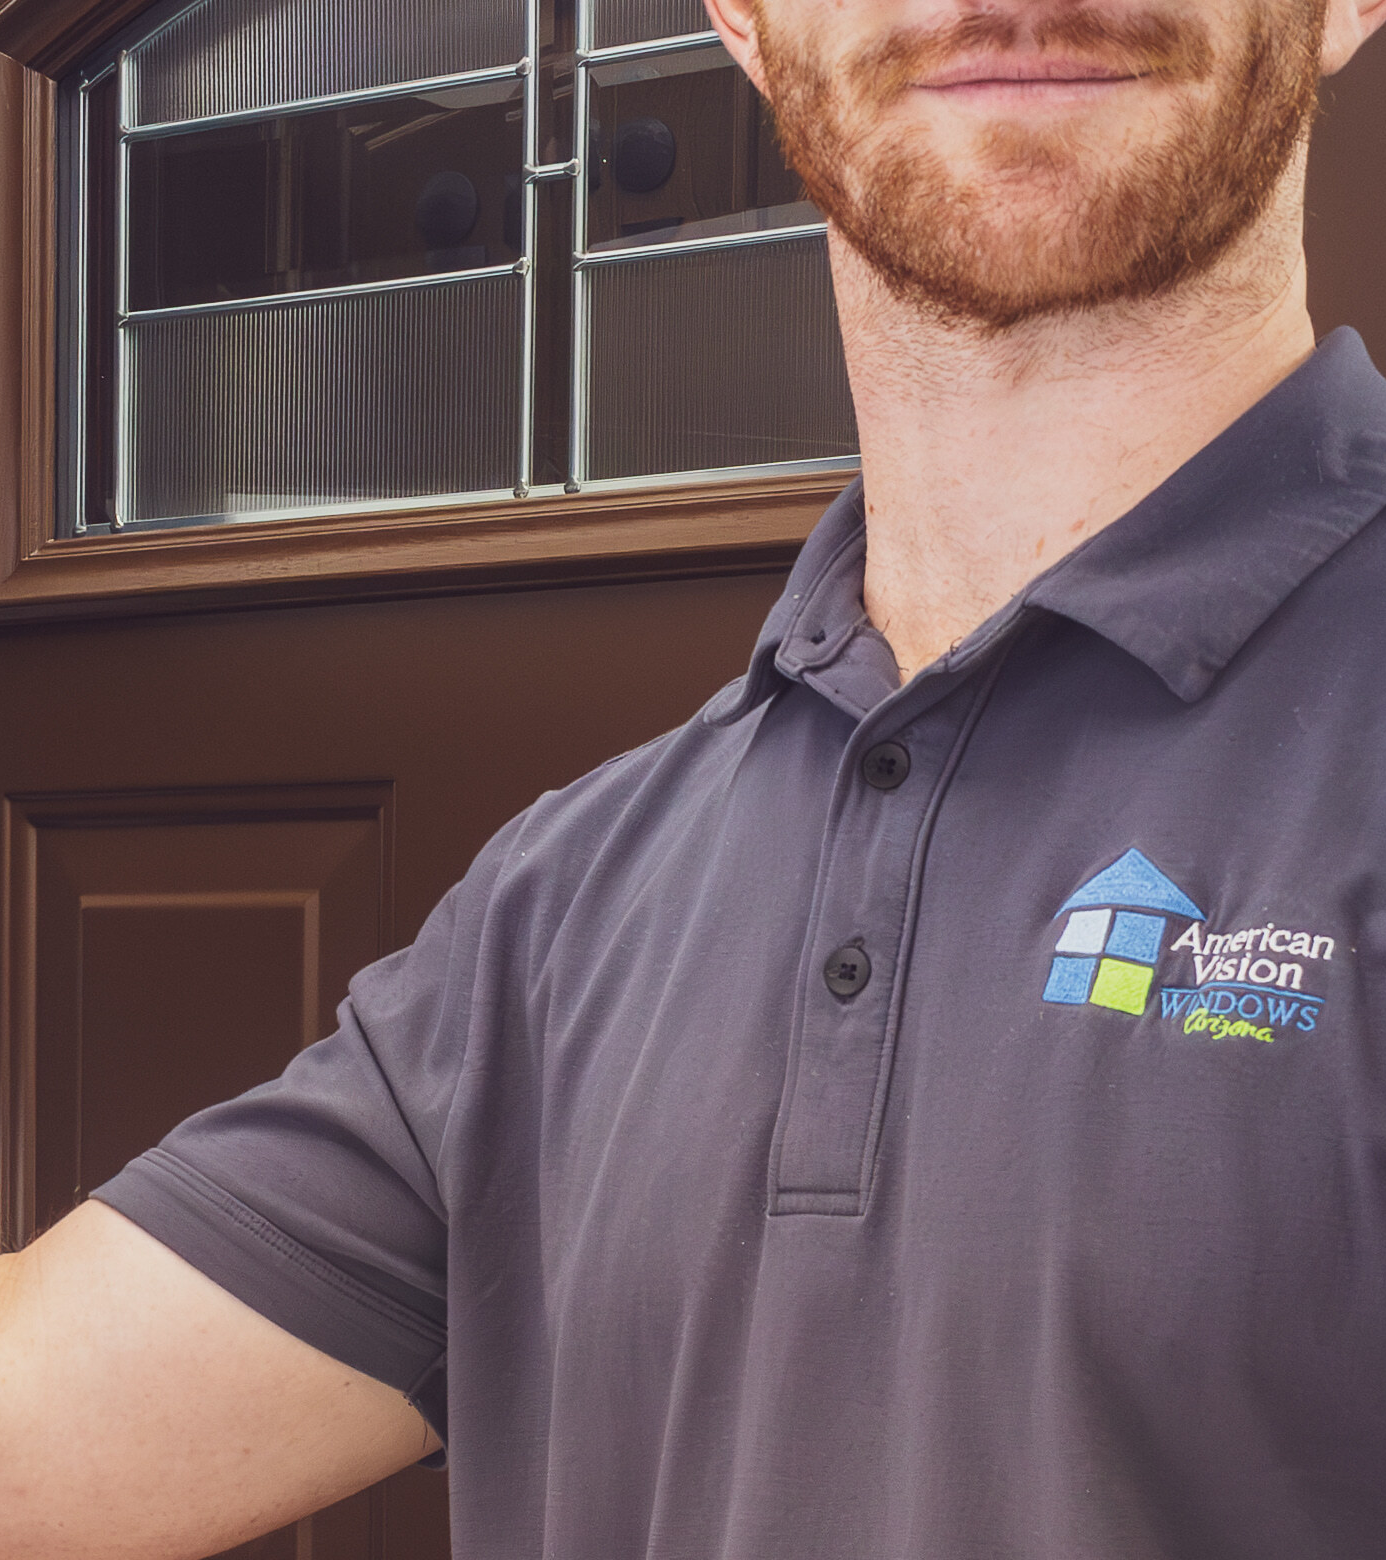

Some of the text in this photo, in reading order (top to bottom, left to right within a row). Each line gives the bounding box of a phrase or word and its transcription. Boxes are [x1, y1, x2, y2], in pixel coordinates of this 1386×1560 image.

[1170, 921, 1335, 961] American
[1193, 954, 1303, 989] Vision
[1160, 990, 1319, 1031] WINDOWS
[1183, 1008, 1275, 1043] Arizona
